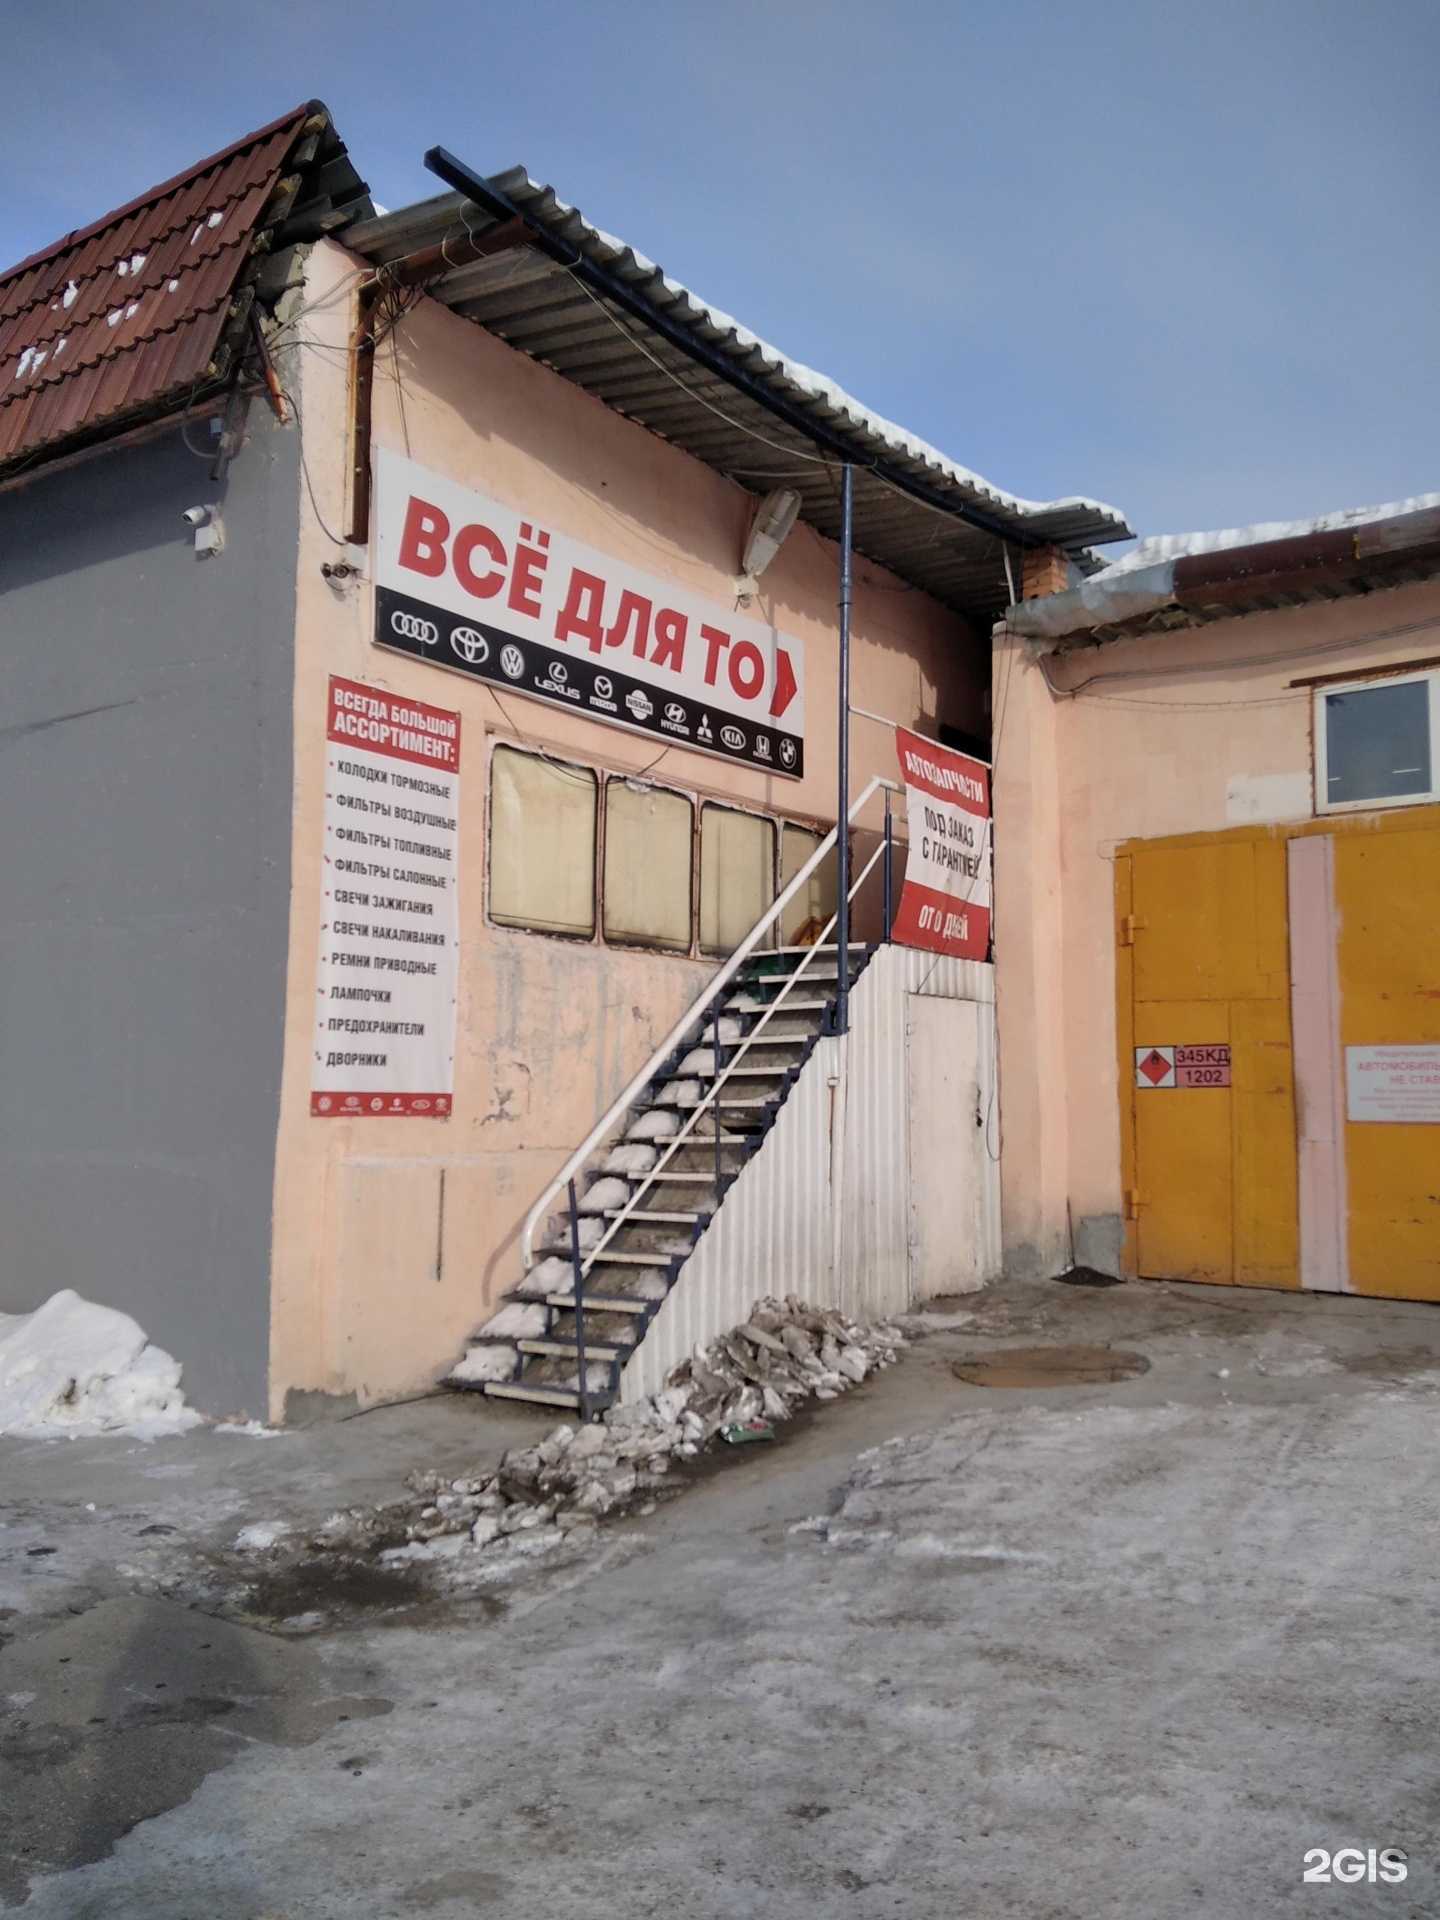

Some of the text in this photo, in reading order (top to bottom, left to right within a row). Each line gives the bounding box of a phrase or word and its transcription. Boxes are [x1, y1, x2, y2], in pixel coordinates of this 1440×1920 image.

[399, 495, 765, 700] ВСЁ ДЛЯ ТО
[534, 676, 581, 700] LEXUS
[334, 688, 456, 739] ВСЕГДА БОЛЬШОЙ
[333, 711, 456, 763] АССОРТИМЕНТ:
[724, 730, 742, 743] KIA
[337, 760, 450, 799] КОЛОДКИ ТОРМОЗНЫЕ
[905, 750, 984, 803] АВТОЗАПЧАСТИ
[336, 794, 457, 831] ФИЛЬТРЫ ВОЗДУШНЫЕ
[924, 806, 974, 848] ПОД ЗАКАЗ
[335, 827, 452, 861] ФИЛЬТРЫ ТОПЛИВНЫЕ
[922, 836, 930, 860] С
[334, 858, 447, 889] ФИЛЬТРЫ САЛОННЫЕ
[334, 889, 433, 916] СВЕЧИ ЗАЖИГАНИЯ
[918, 904, 935, 930] ОТ
[333, 921, 445, 946] СВЕЧИ НАКАЛИВАНИЯ
[331, 952, 437, 975] РЕМНИ ПРИВОДНЫЕ
[330, 986, 391, 1003] ЛАМПОЧКИ
[328, 1018, 425, 1036] ПРЕДОХРАНИТЕЛИ
[326, 1052, 387, 1067] ДВОРНИКИ
[1185, 1070, 1223, 1083] 1202
[1390, 1074, 1407, 1085] НЕ
